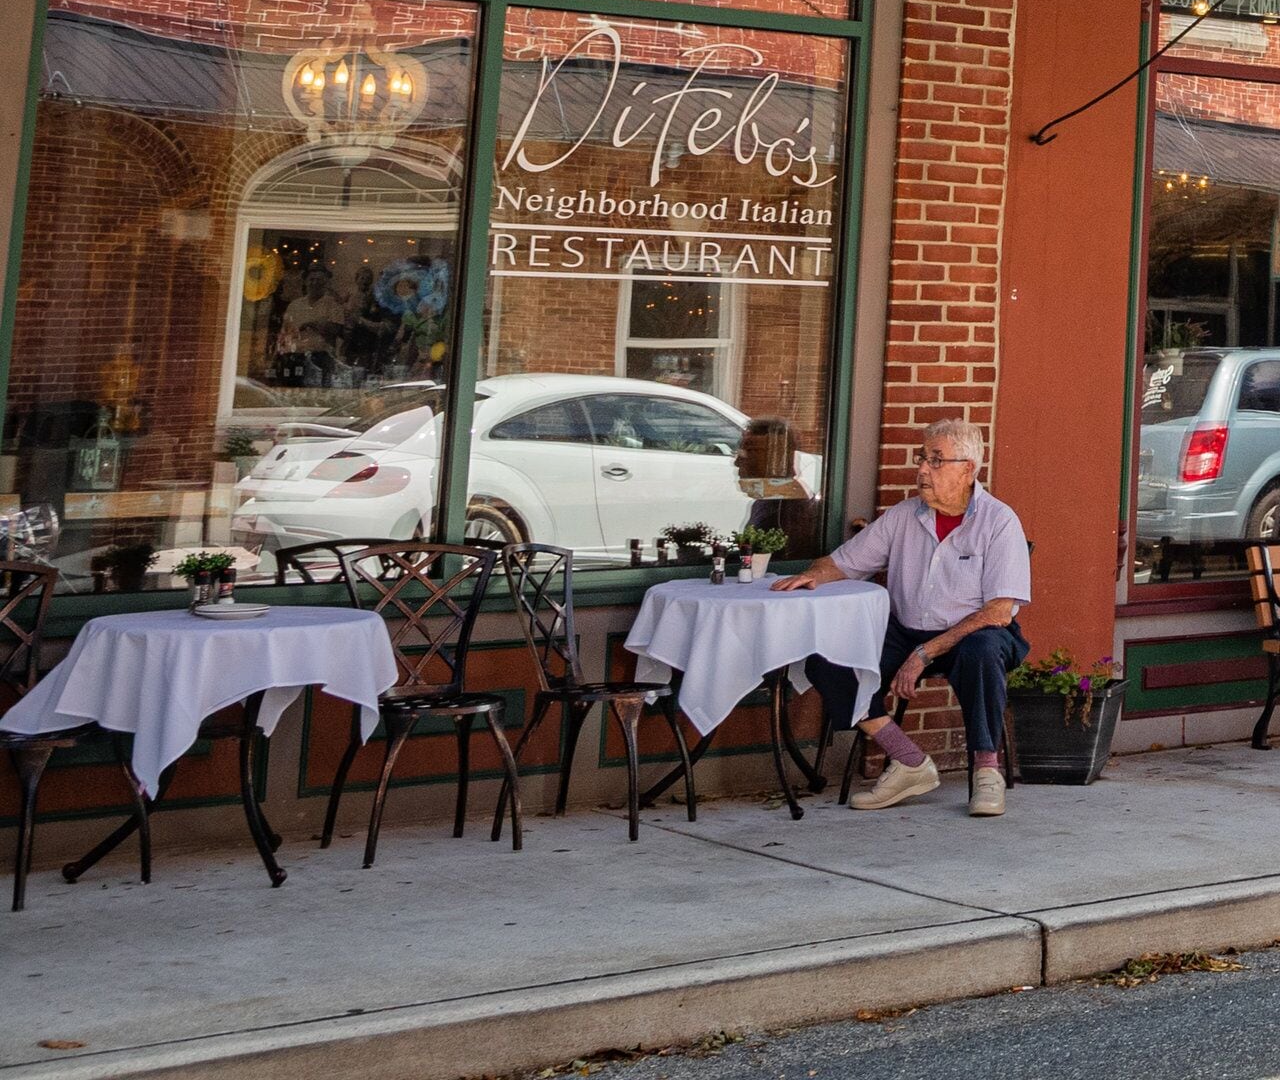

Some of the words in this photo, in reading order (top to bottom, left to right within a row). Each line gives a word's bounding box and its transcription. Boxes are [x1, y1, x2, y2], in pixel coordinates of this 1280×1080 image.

[495, 185, 728, 221] Neighborhood
[739, 198, 833, 226] Italian
[491, 233, 832, 276] RESTAURANT
